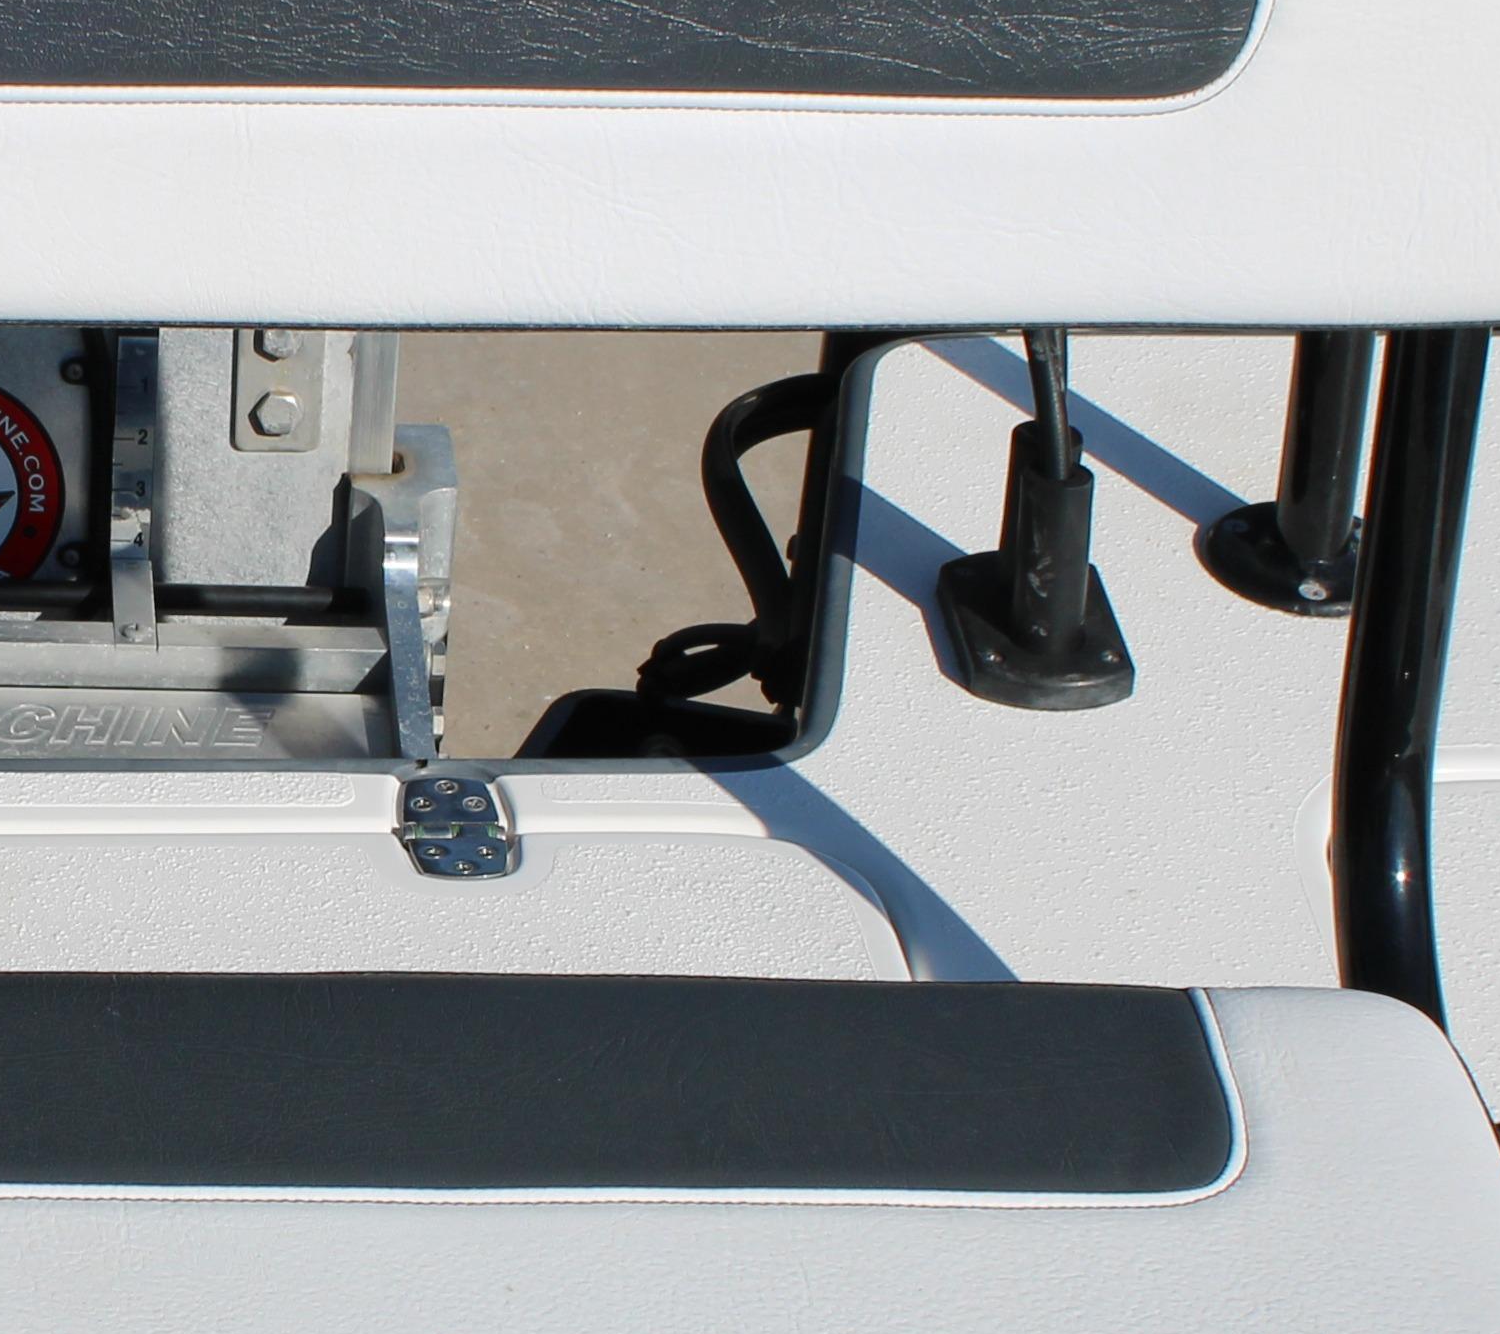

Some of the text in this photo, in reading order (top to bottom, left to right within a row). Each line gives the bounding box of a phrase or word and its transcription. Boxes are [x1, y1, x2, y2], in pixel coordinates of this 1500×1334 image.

[137, 429, 149, 445] 2
[135, 481, 146, 498] 3
[133, 531, 144, 548] 4
